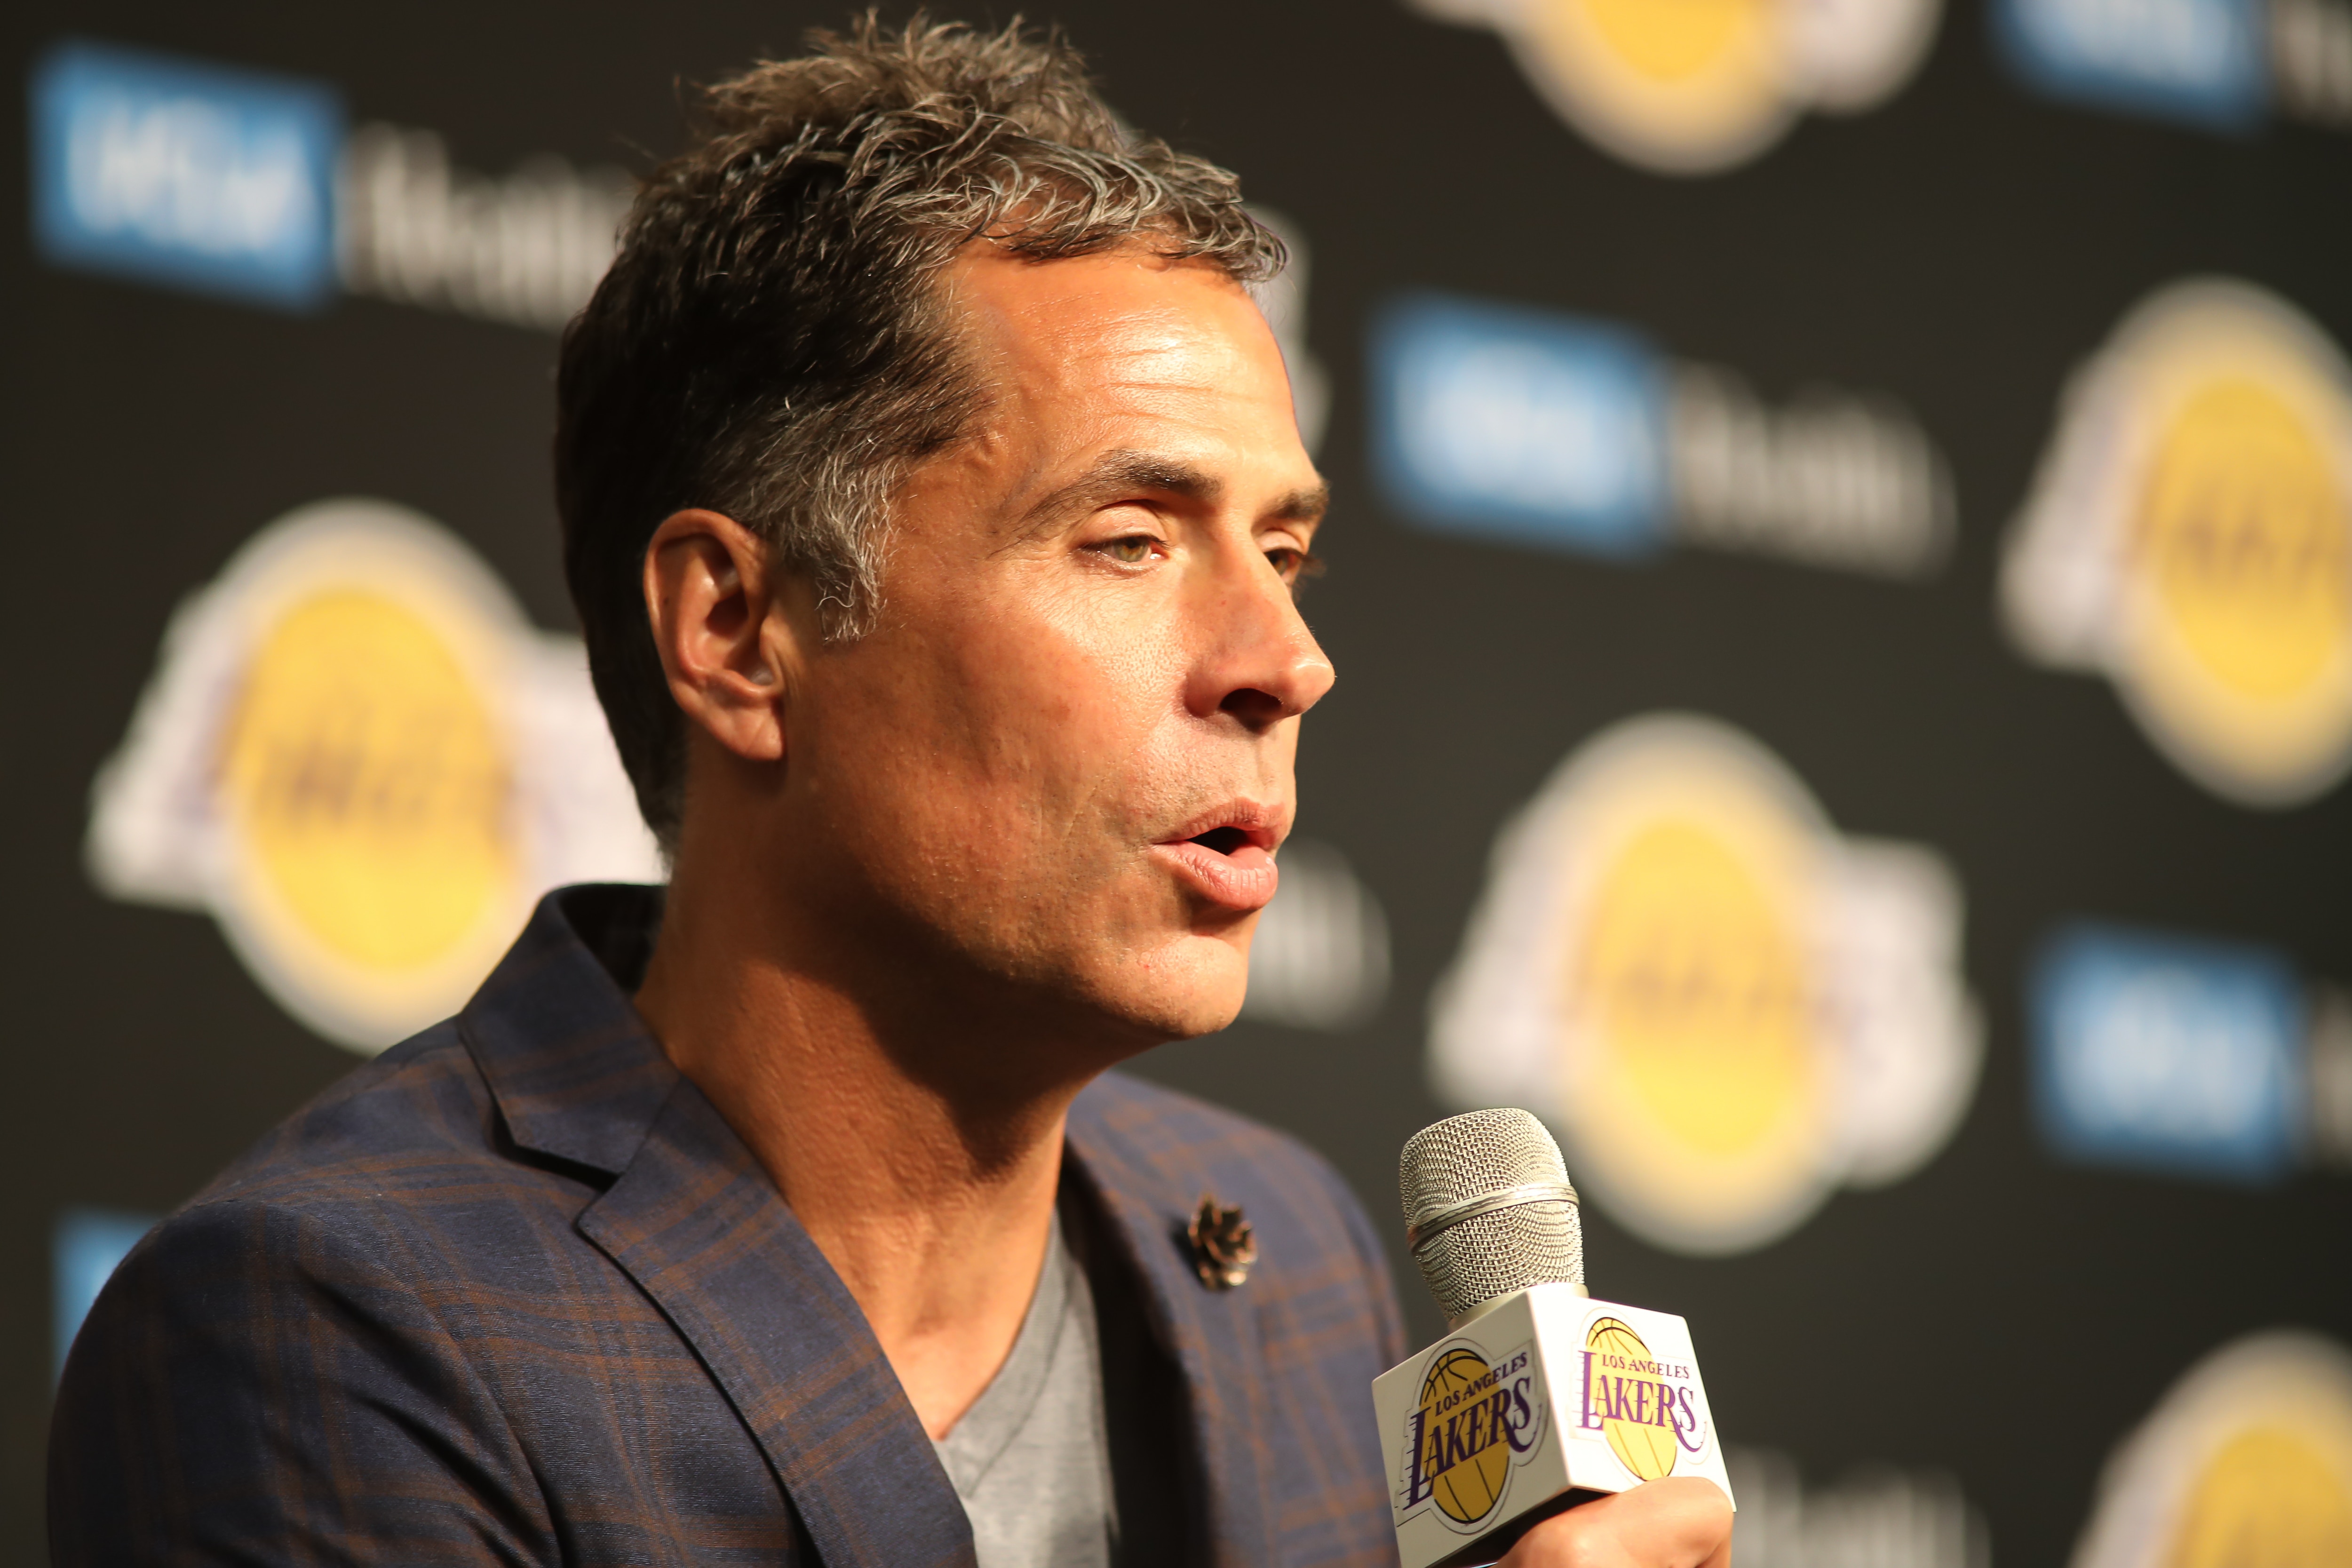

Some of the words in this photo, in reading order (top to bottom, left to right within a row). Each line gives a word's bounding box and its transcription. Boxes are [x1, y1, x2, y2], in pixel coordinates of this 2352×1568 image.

[1436, 1390, 1460, 1417] LOS
[1462, 1352, 1527, 1401] ANGELES
[1576, 1350, 1708, 1453] LAKERS
[1602, 1354, 1626, 1369] LOS
[1628, 1359, 1690, 1379] ANGELES
[1402, 1376, 1542, 1511] LAKERS
